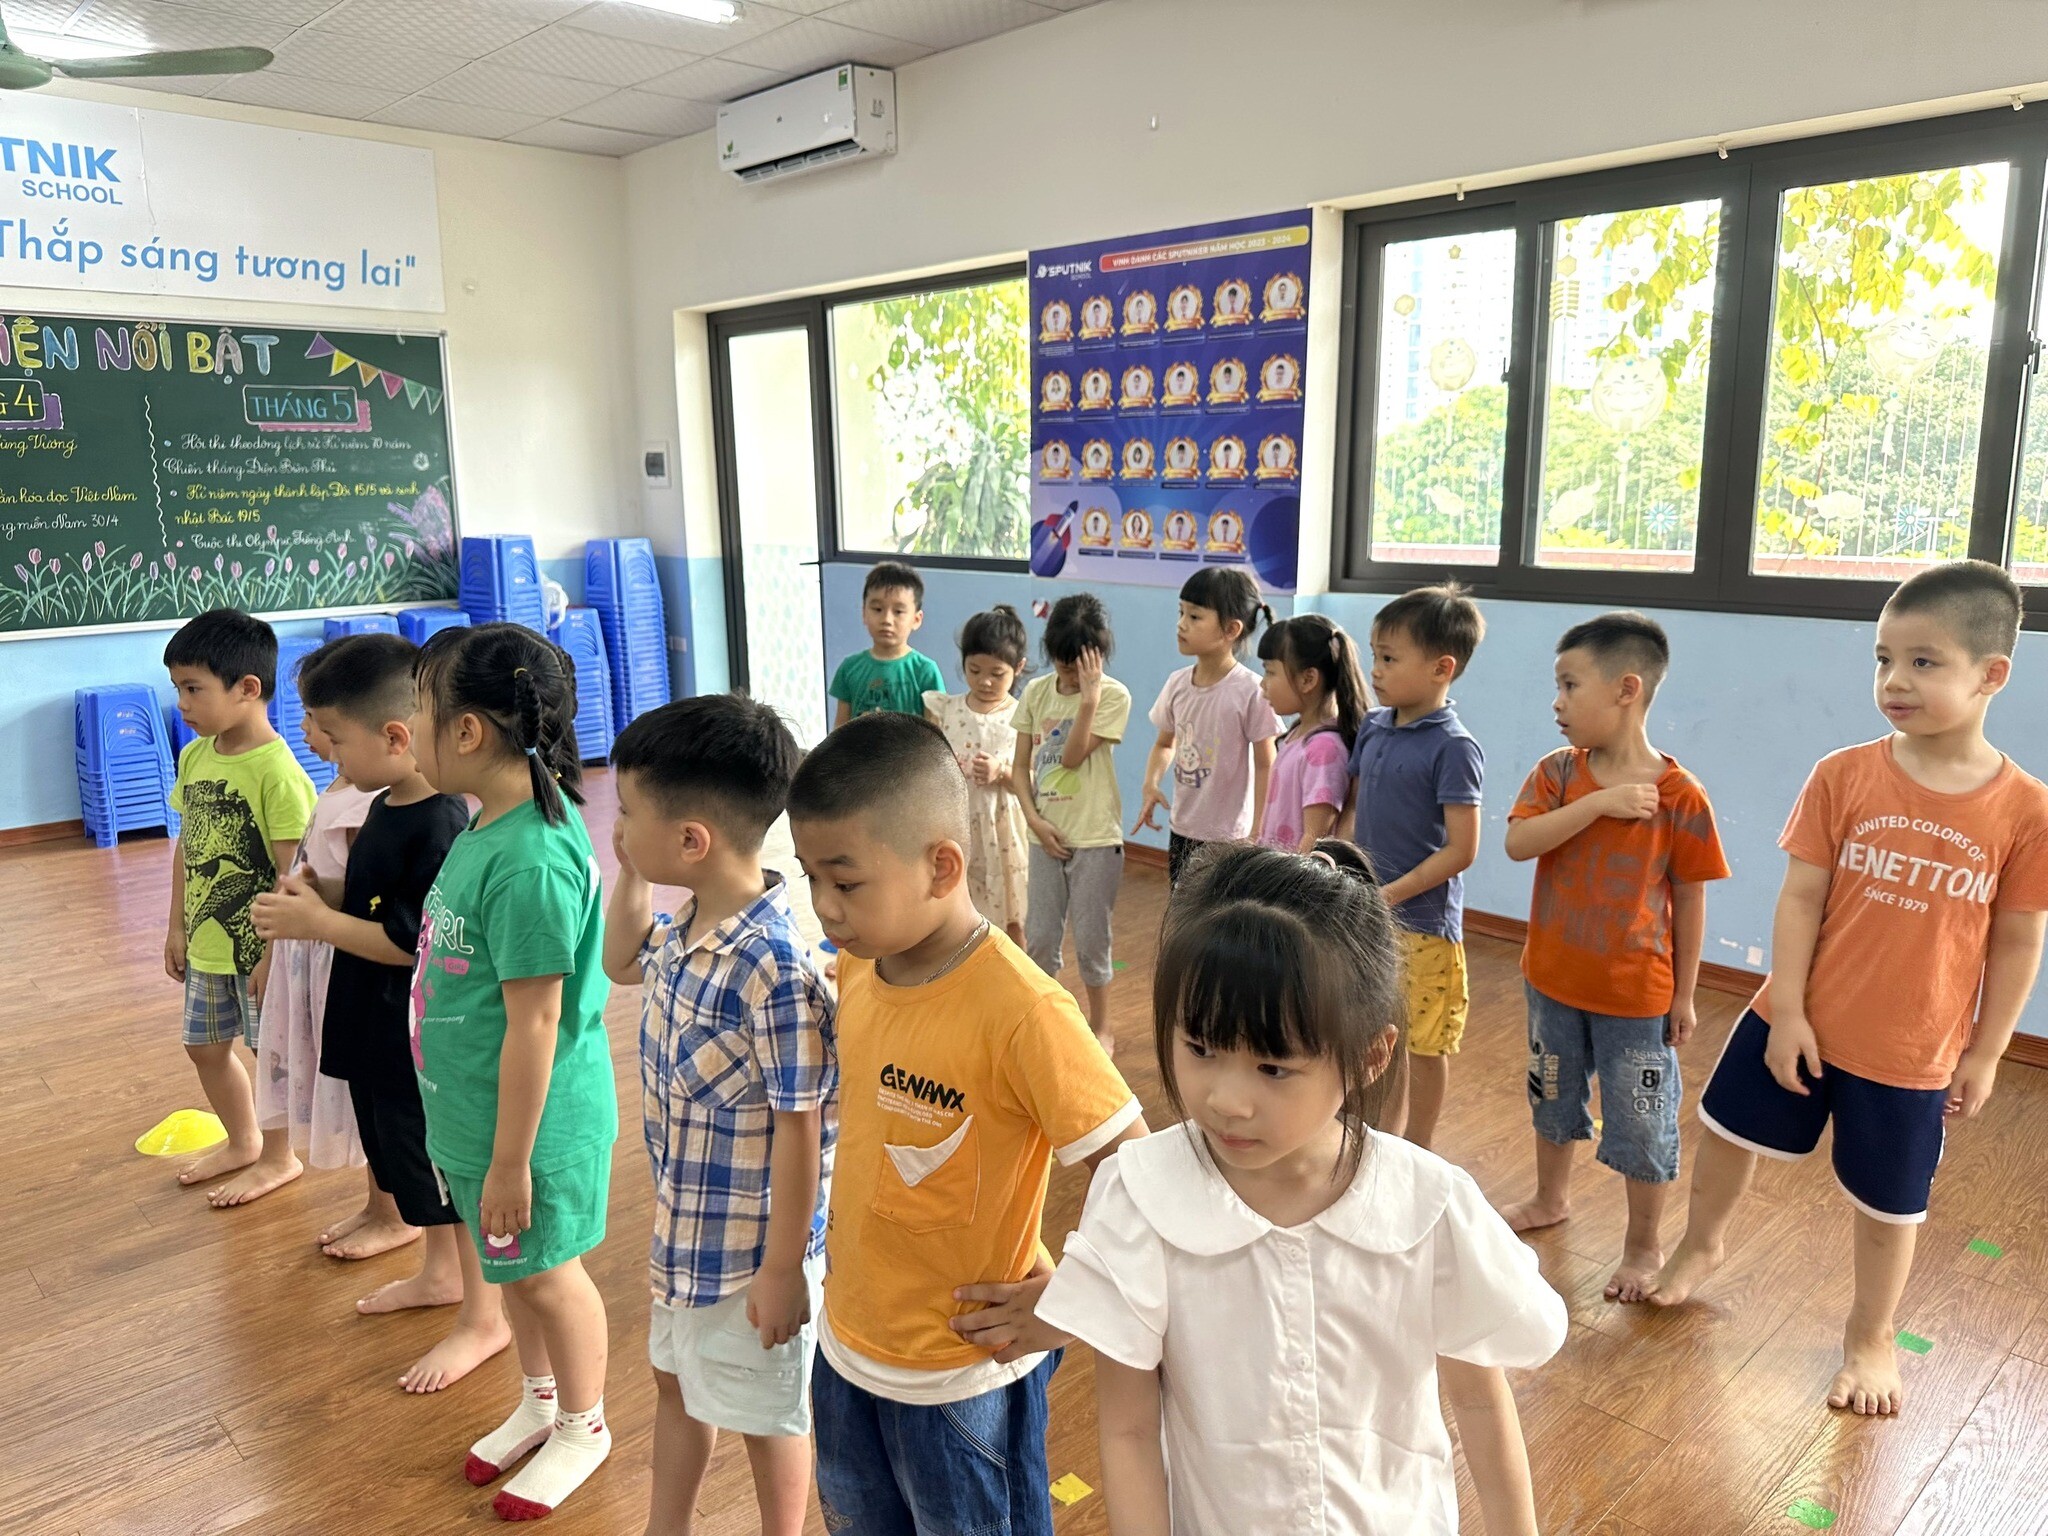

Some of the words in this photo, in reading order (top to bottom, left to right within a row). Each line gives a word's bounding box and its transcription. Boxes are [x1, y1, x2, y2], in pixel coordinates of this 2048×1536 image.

[0, 137, 120, 183] TNIK
[22, 180, 123, 205] SCHOOL
[0, 217, 103, 273] Thắp
[121, 236, 218, 282] sáng
[235, 245, 346, 291] tương
[361, 249, 417, 287] lai"
[1048, 260, 1092, 277] SPUTNIK
[187, 327, 280, 385] BẬT
[14, 384, 39, 417] 4
[249, 391, 327, 419] THÁNG
[332, 392, 352, 421] 5
[209, 434, 226, 450] thi
[20, 487, 45, 503] hóa
[101, 485, 138, 501] Nam
[51, 513, 87, 529] Nam
[91, 514, 119, 528] 30/4
[226, 533, 243, 548] thi
[1855, 816, 1910, 836] UNITED
[1912, 819, 1972, 850] COLORS
[1967, 845, 1987, 863] OF
[1863, 886, 1897, 905] SNCE
[1899, 896, 1929, 914] 1979
[1641, 1069, 1658, 1088] 8
